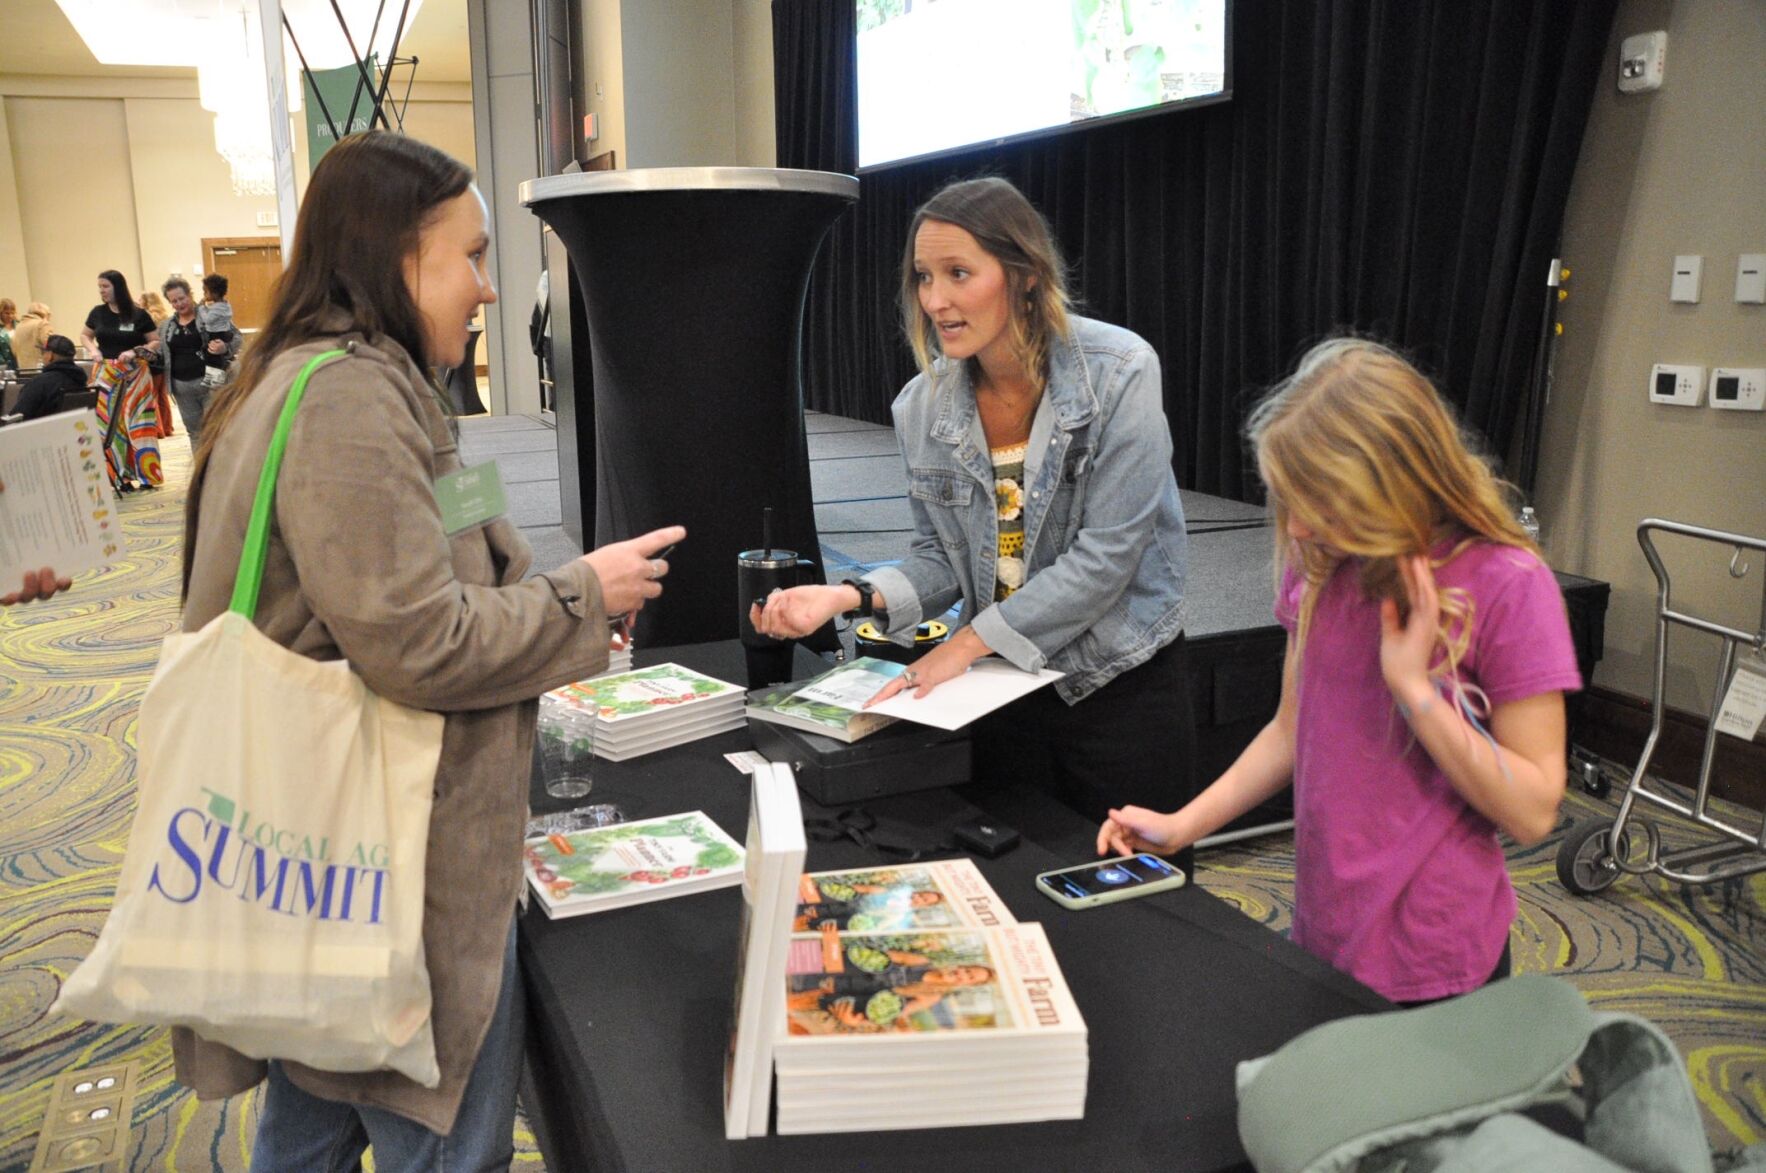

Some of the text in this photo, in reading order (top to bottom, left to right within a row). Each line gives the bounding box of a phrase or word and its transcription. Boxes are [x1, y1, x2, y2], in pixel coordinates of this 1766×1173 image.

[317, 117, 368, 137] PRODUERS
[237, 810, 390, 867] LOCAL AG
[147, 808, 391, 925] SUMMIT
[966, 895, 1000, 927] Farm
[1022, 977, 1061, 1026] Farm
